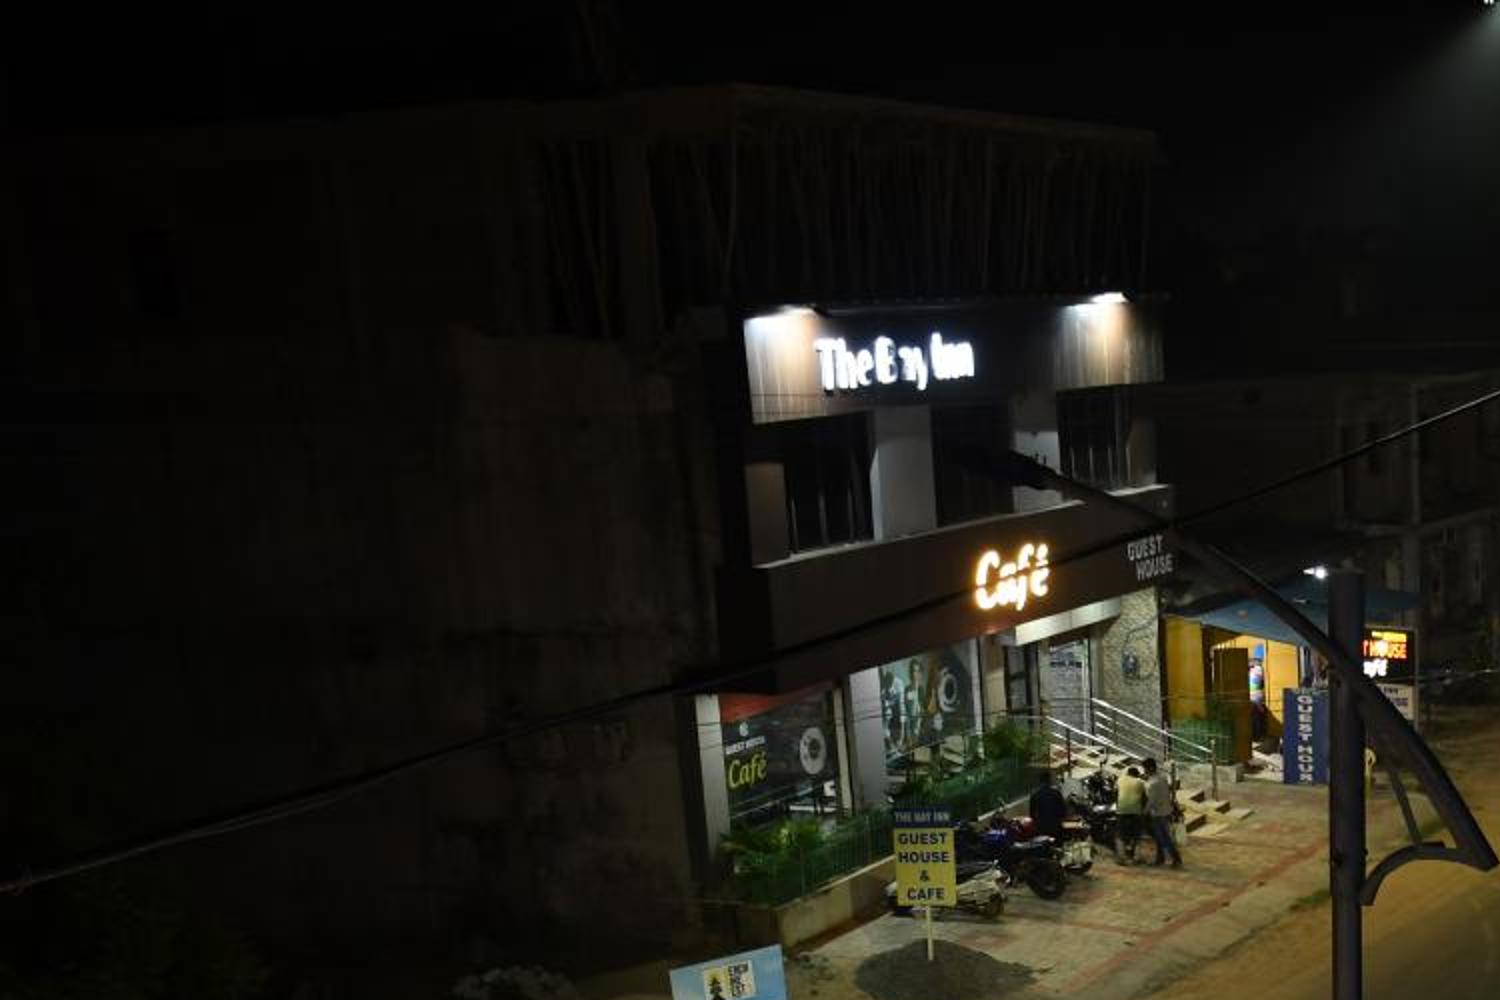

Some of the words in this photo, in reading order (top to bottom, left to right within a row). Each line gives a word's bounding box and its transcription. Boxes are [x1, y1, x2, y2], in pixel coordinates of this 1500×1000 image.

[813, 337, 874, 391] The
[930, 331, 975, 380] Inn
[1127, 535, 1164, 561] GUEST
[1136, 553, 1173, 582] HOUSE
[898, 831, 948, 846] GUEST
[898, 850, 951, 865] HOUSE
[919, 870, 930, 882] &
[906, 887, 945, 901] CAFE
